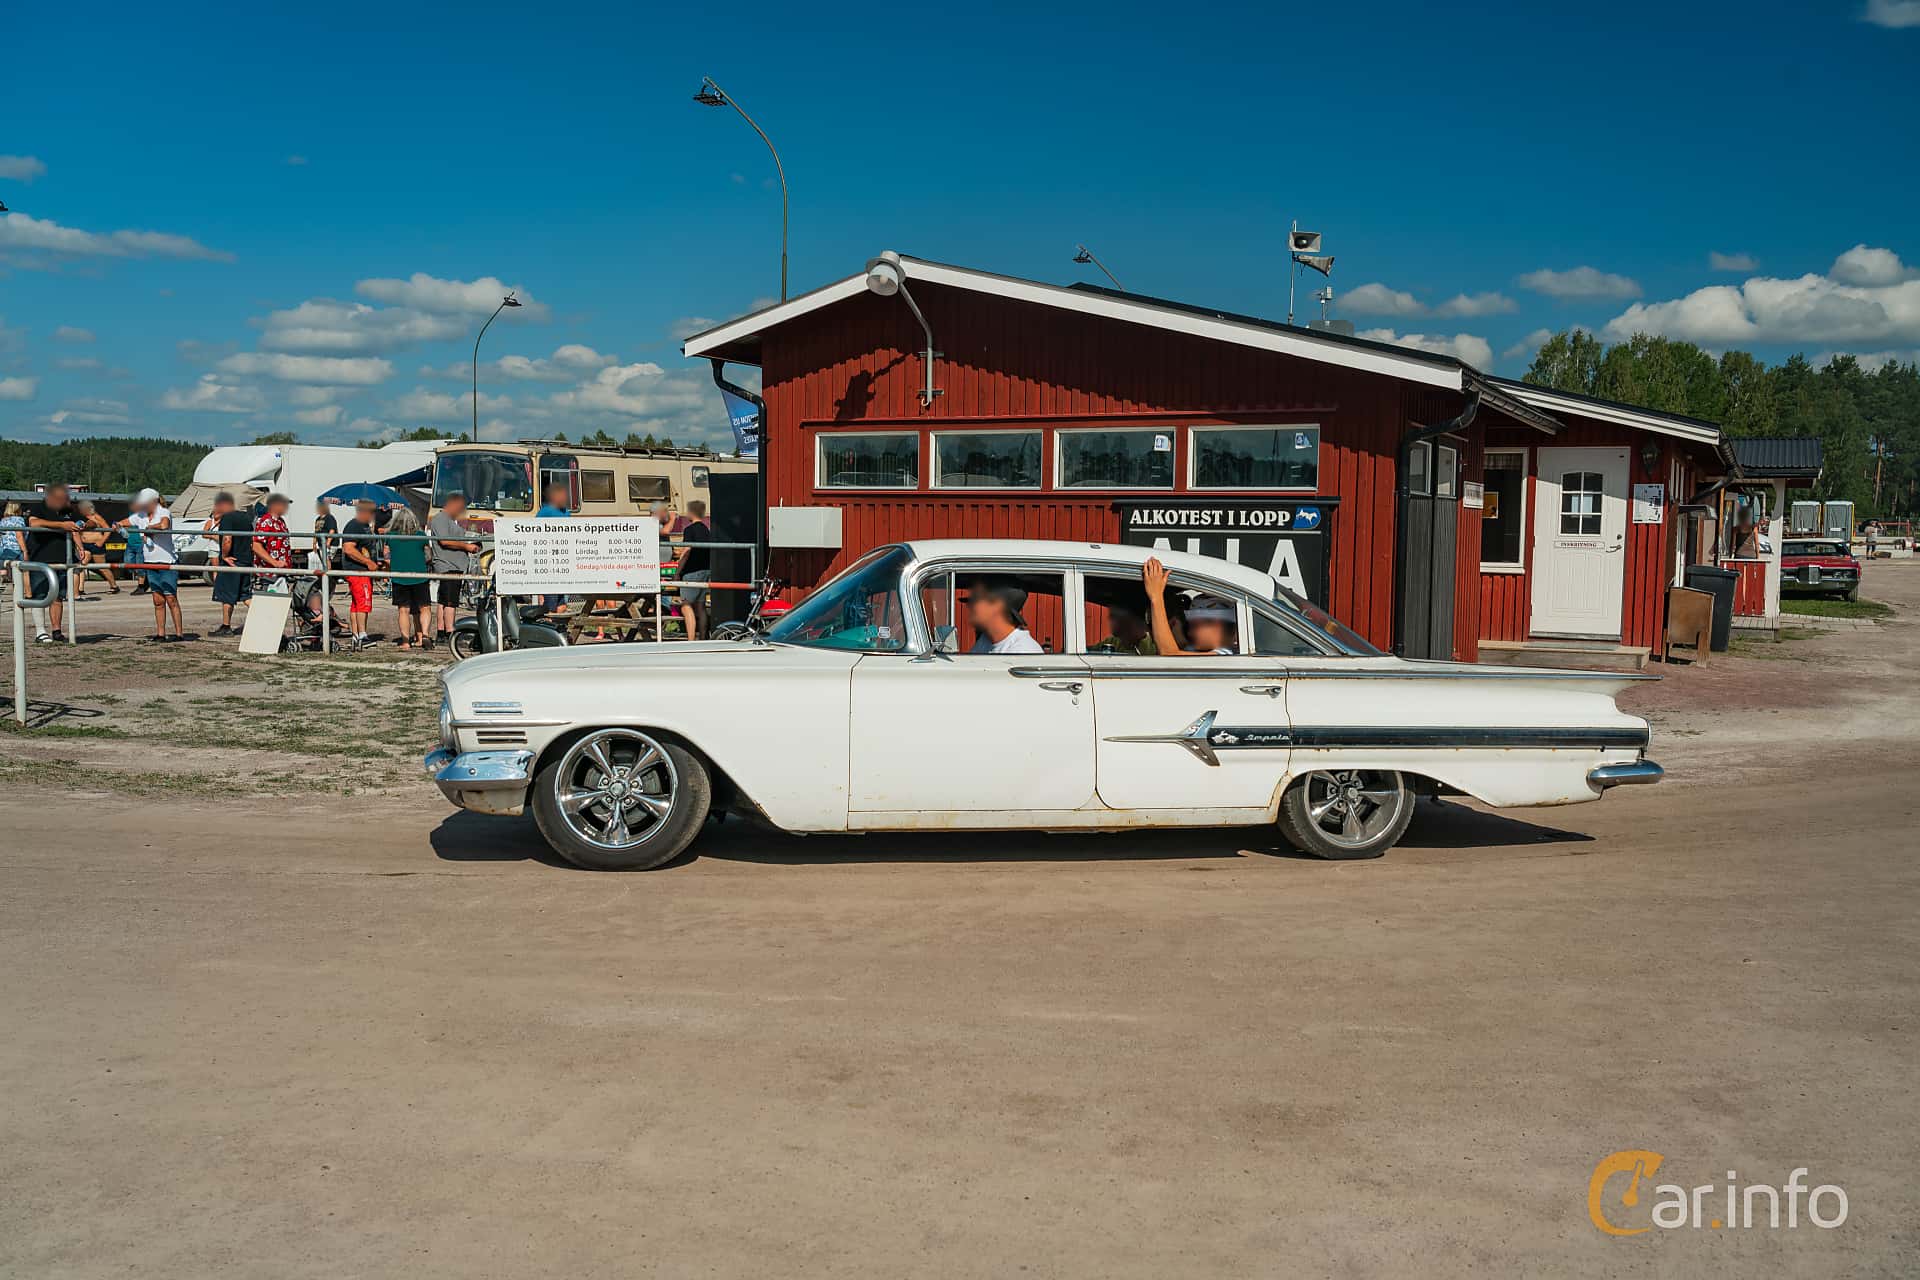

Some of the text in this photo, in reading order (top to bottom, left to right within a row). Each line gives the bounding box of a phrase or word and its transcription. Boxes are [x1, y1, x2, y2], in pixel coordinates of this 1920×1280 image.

[1129, 509, 1291, 526] ALKOTEST I LOPP
[514, 523, 640, 534] Stora banans öppettider
[500, 539, 527, 547] Måndag
[575, 538, 598, 546] Fredag
[500, 558, 526, 566] Onsdag
[1244, 734, 1290, 742] Impala
